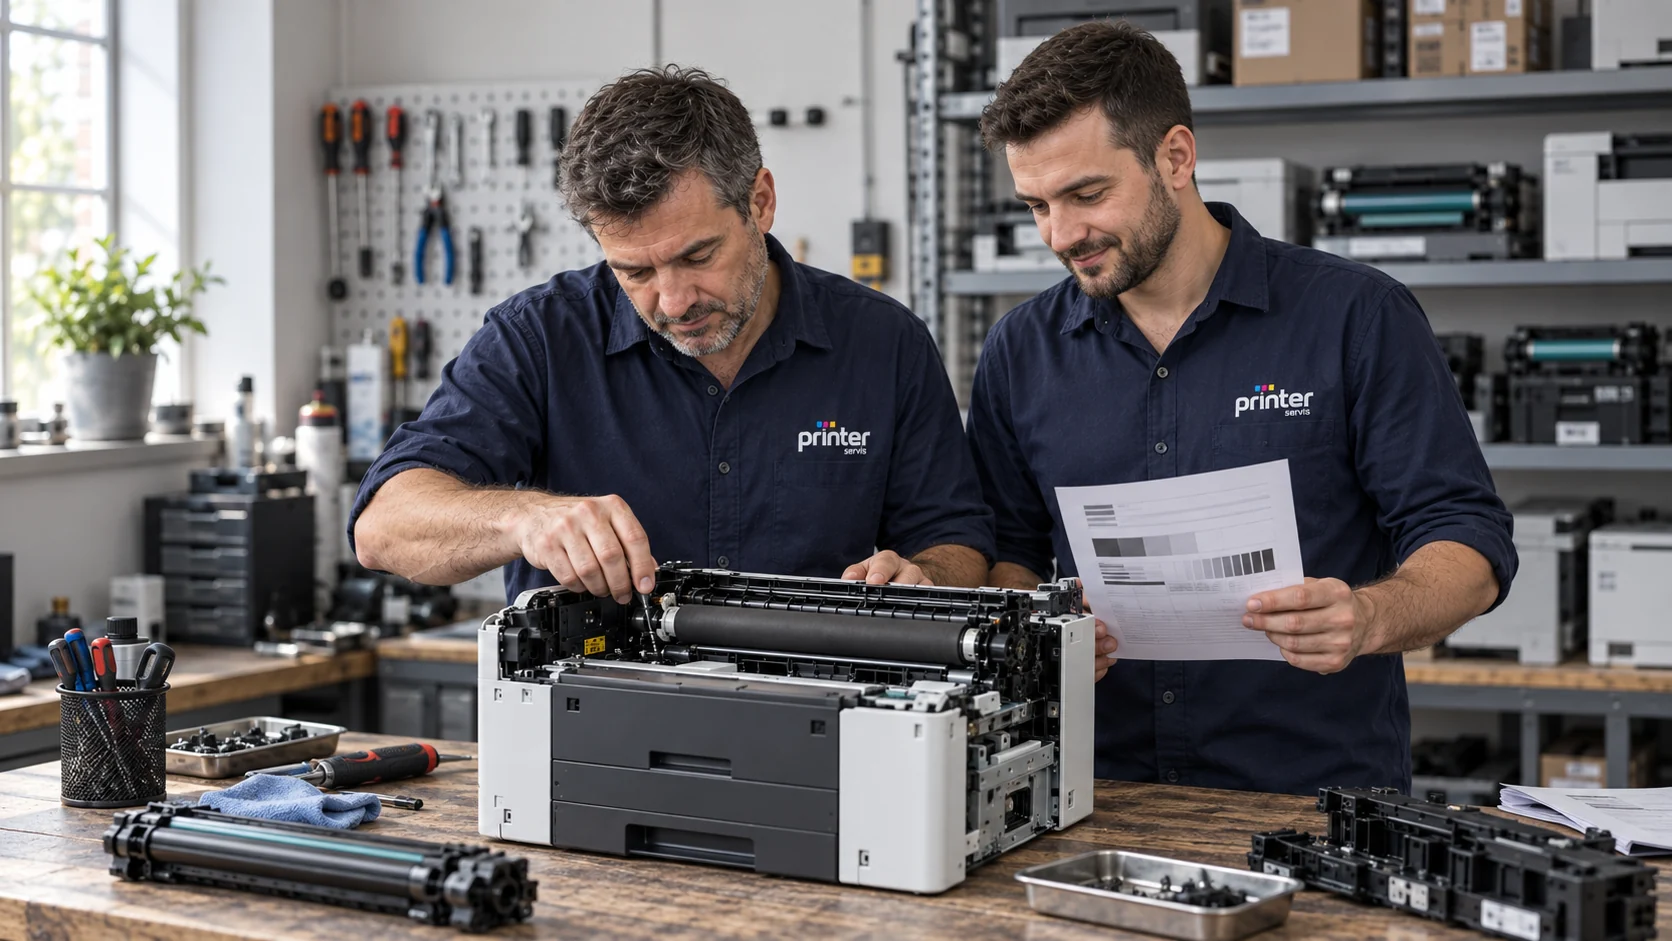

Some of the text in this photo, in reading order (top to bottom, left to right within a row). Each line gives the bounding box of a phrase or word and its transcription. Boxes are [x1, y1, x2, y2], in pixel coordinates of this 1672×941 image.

[1235, 389, 1314, 417] printer
[1285, 408, 1310, 416] servis
[798, 427, 871, 452] printer
[844, 446, 867, 455] servis
